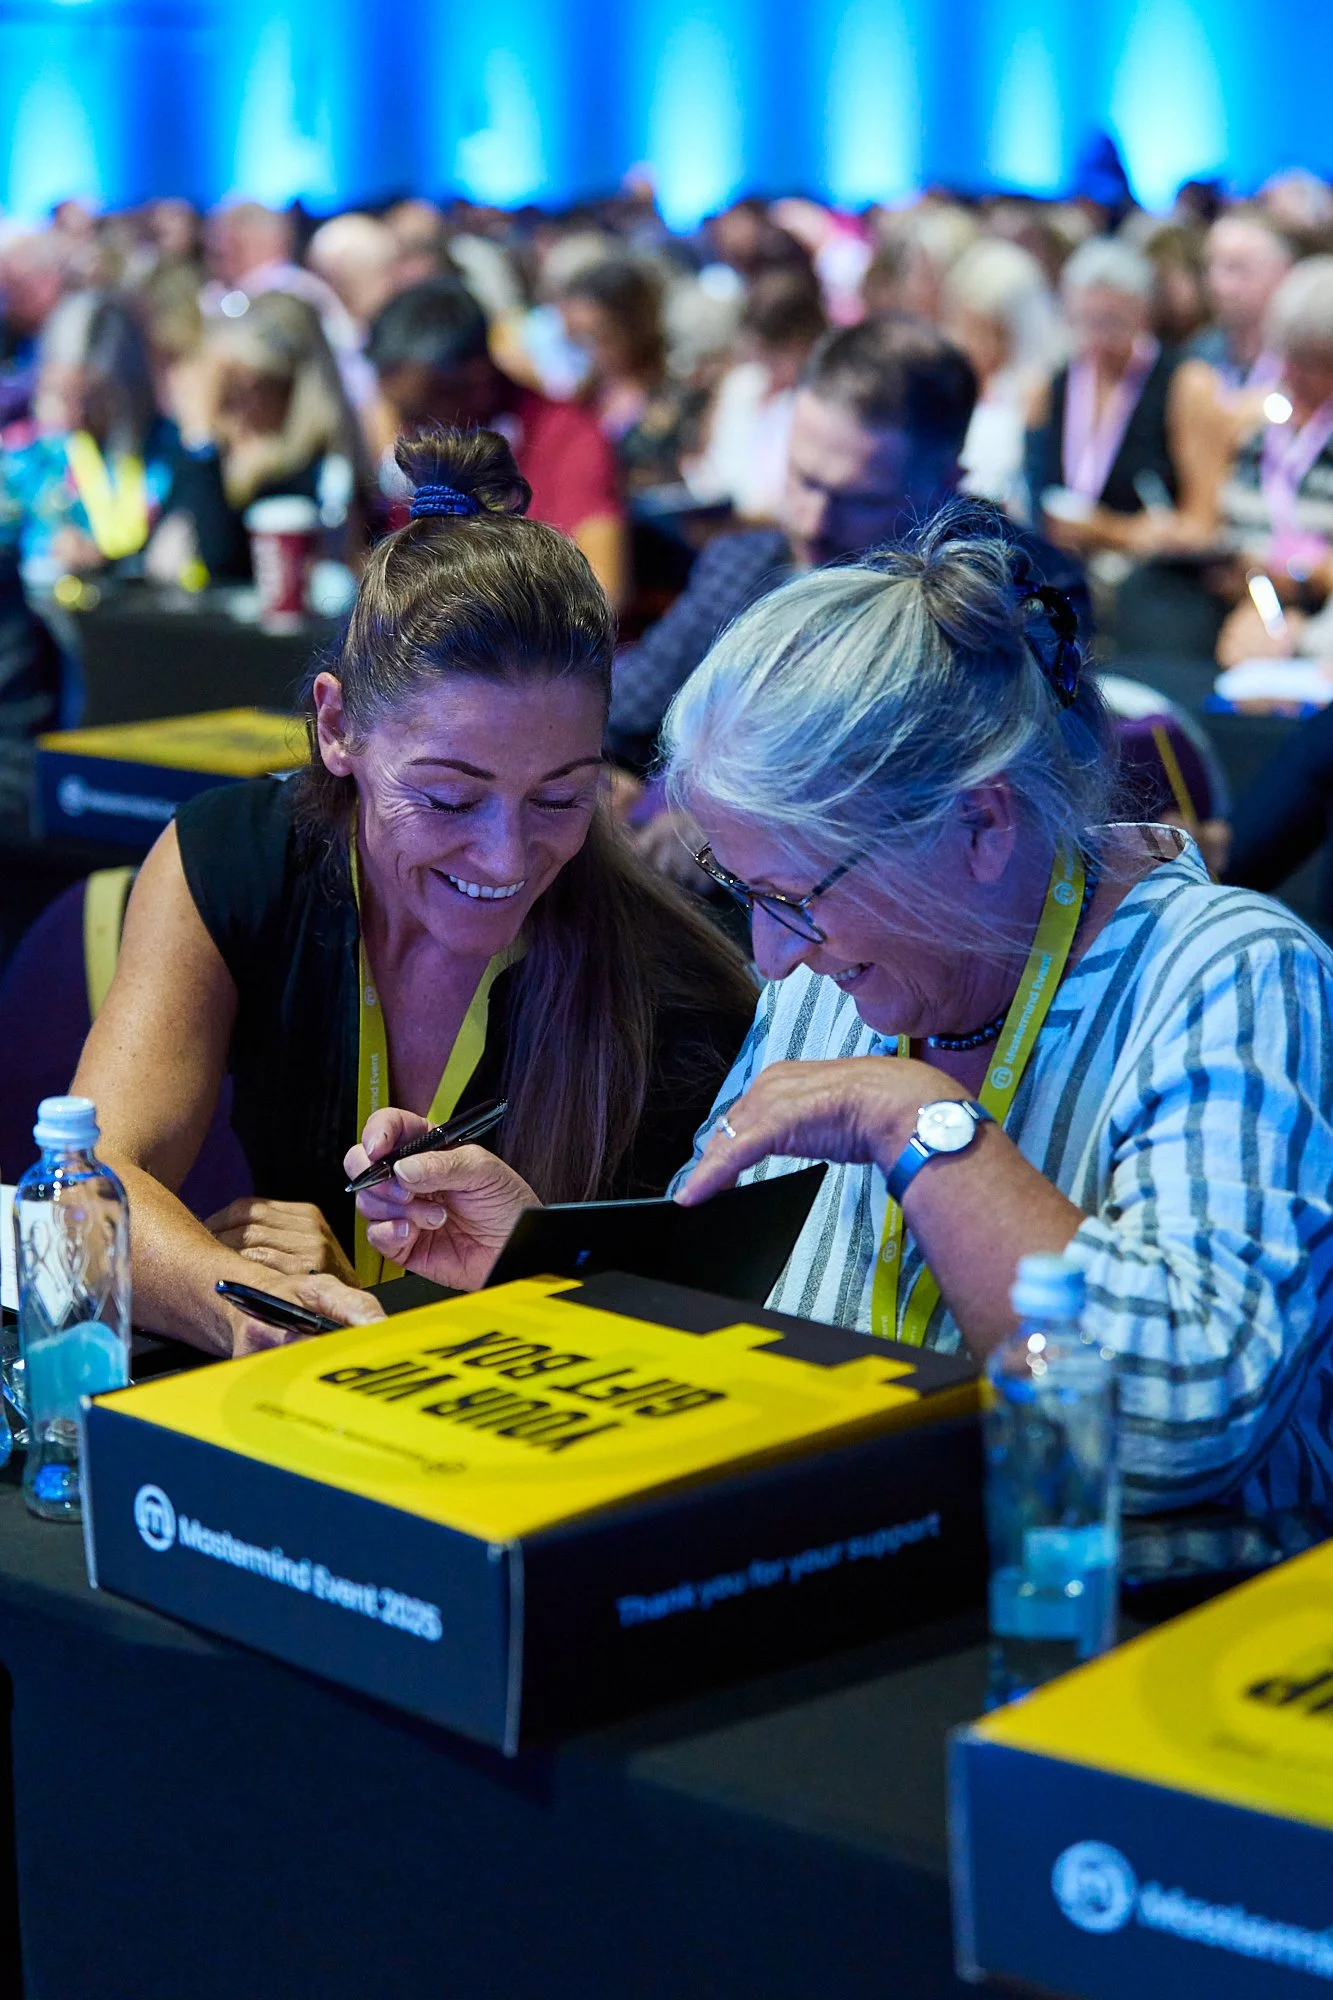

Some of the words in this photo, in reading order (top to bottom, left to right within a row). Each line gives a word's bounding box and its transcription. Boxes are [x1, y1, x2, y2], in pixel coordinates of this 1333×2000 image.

[1003, 990, 1040, 1065] Mastermind
[1031, 954, 1053, 991] Event
[318, 1360, 459, 1402] VIP
[422, 1331, 596, 1380] BOX
[421, 1387, 624, 1455] YOUR
[547, 1367, 729, 1418] GIFT
[178, 1514, 312, 1593] Mastermind
[311, 1562, 379, 1618] Event
[616, 1580, 697, 1628] Thank
[700, 1571, 748, 1611] you
[748, 1558, 786, 1588] for
[787, 1541, 844, 1584] your
[846, 1511, 941, 1560] support
